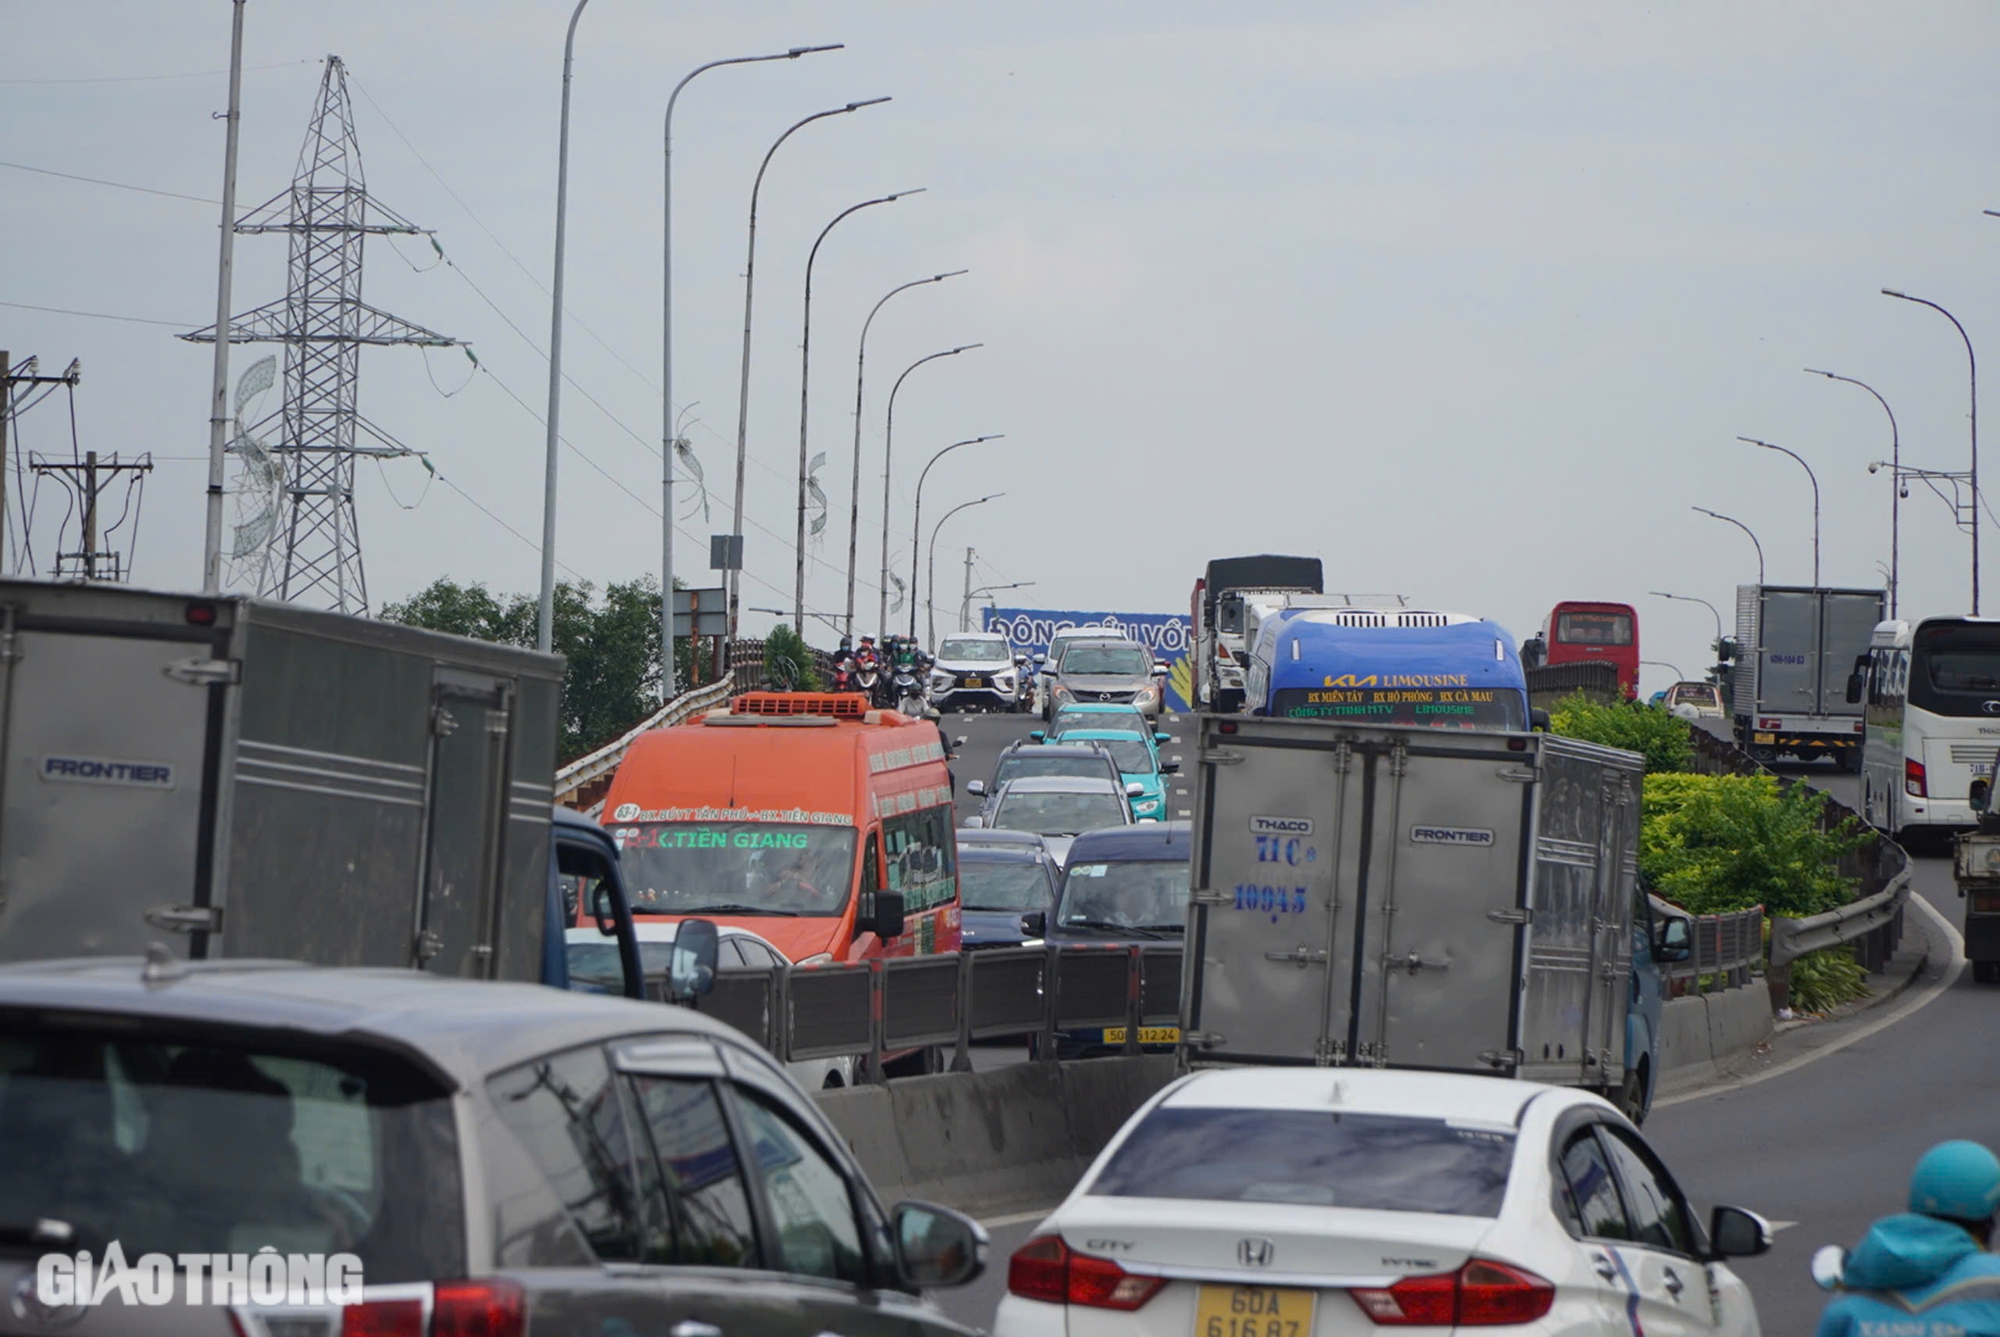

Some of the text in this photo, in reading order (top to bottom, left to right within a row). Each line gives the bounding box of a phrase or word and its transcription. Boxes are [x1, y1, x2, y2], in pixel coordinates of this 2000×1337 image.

[1324, 674, 1469, 687] KIA LIMOUSINE
[1308, 692, 1320, 702] BX
[1373, 692, 1385, 702] BX
[1440, 691, 1453, 702] BX
[1470, 691, 1494, 702] MAU
[1319, 706, 1334, 716] TY
[46, 757, 171, 783] FRONTIER
[616, 805, 639, 818] 63-1
[811, 812, 853, 826] GIANG
[1256, 819, 1309, 832] THACO
[733, 832, 808, 849] GIANG
[1414, 828, 1492, 843] FRONTIER
[1231, 1288, 1279, 1316] 60A
